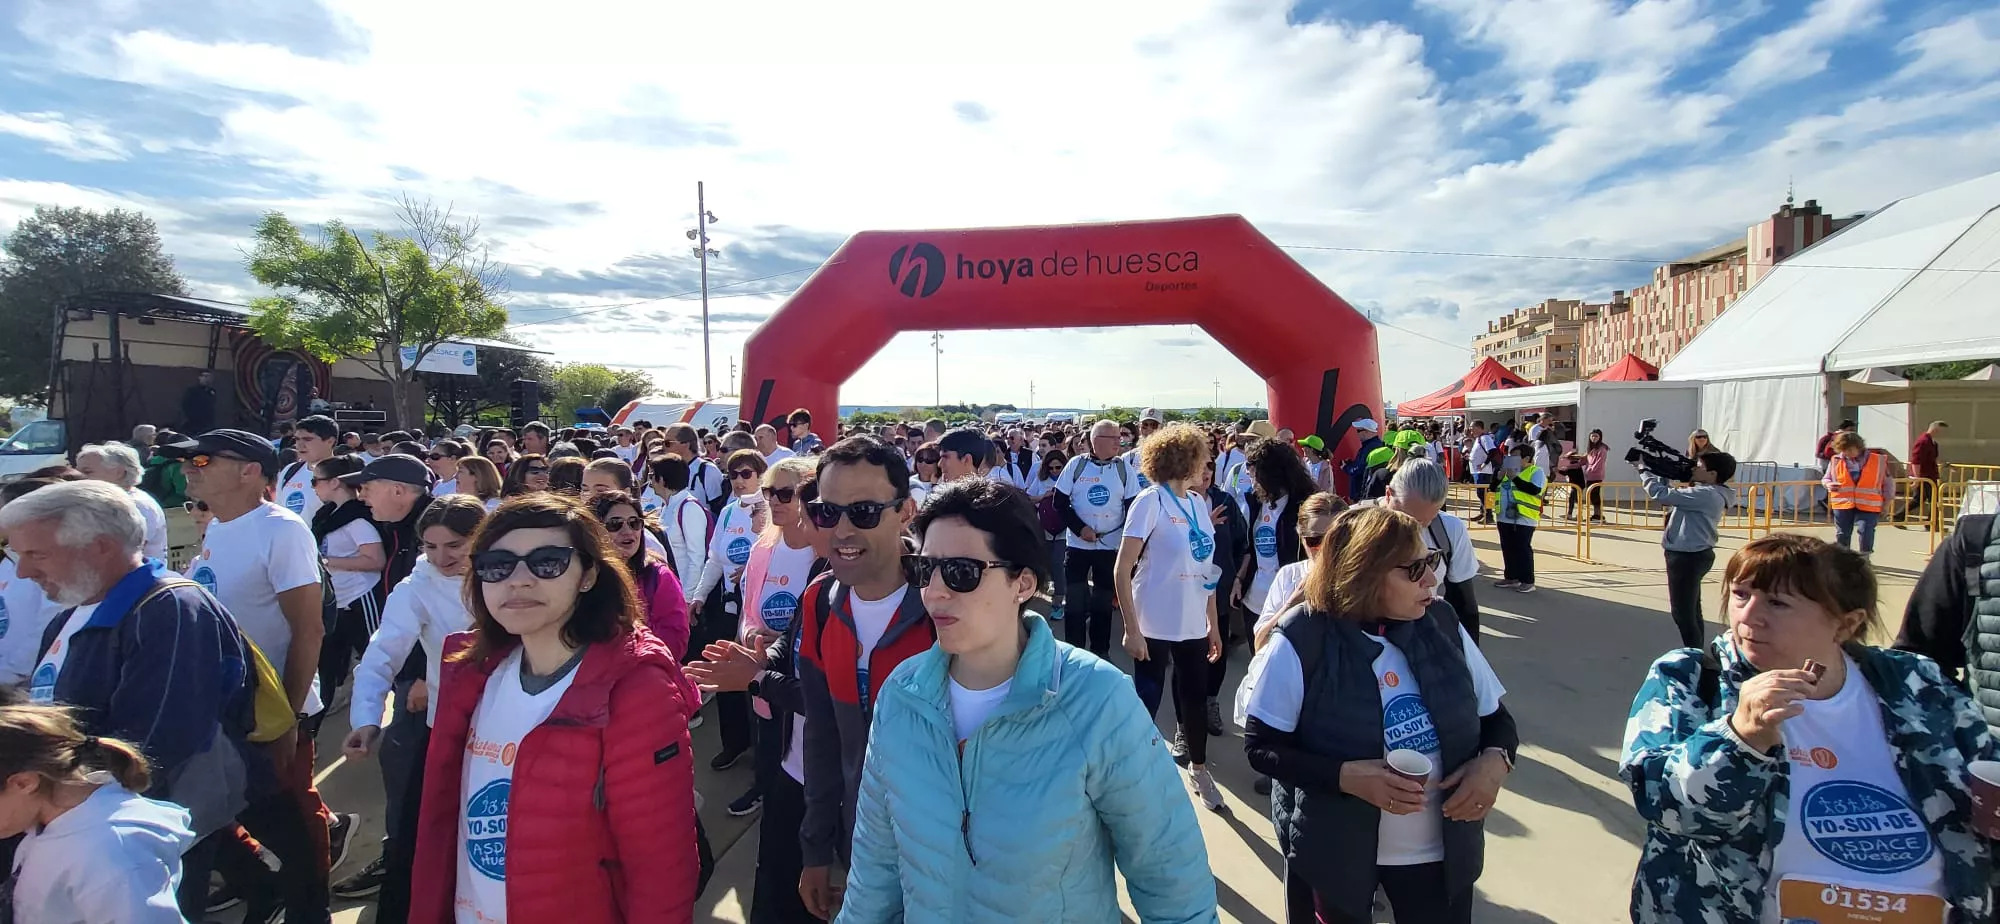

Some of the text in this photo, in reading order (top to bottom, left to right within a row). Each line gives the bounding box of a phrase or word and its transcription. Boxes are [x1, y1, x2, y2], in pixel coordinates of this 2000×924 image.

[957, 250, 1199, 284] hoya de huesca
[1145, 280, 1198, 291] Deportes
[1831, 837, 1920, 852] ASDACE
[1842, 850, 1913, 862] Huesca
[1820, 887, 1907, 913] 01534
